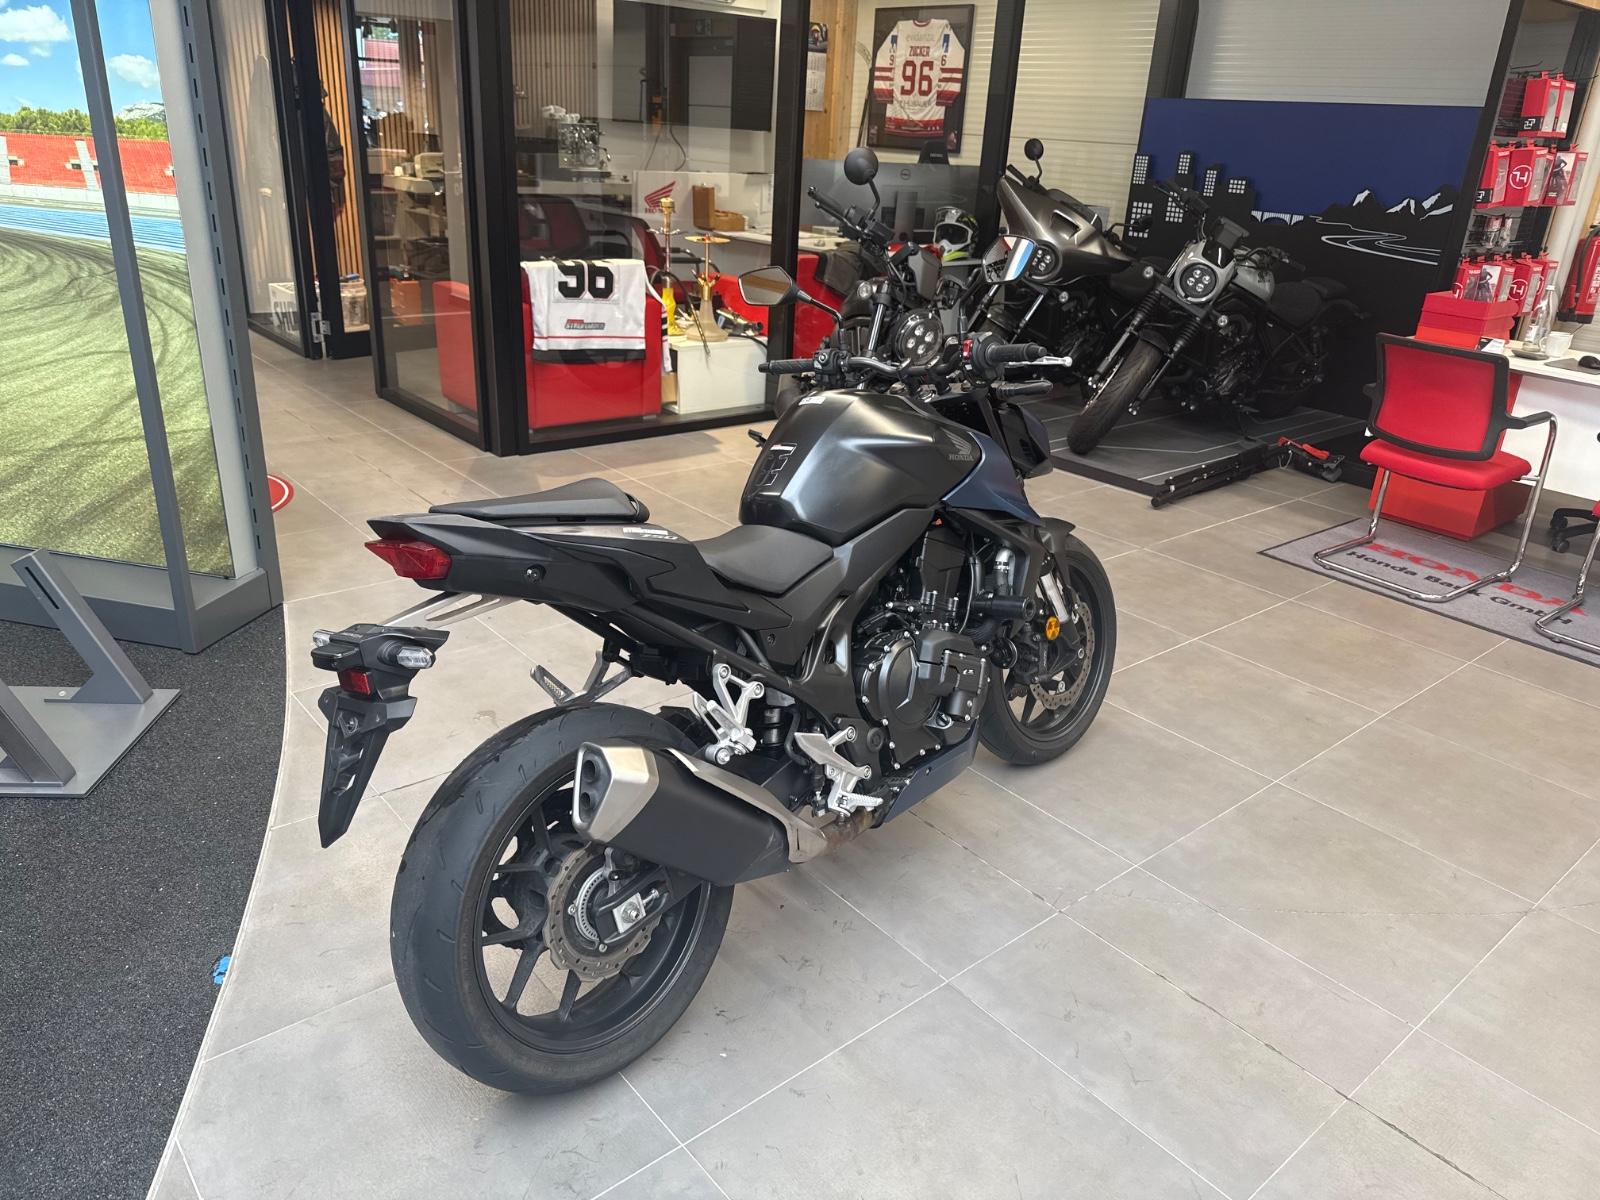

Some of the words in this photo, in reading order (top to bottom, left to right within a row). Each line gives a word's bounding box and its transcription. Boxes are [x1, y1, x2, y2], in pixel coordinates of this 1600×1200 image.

[900, 60, 934, 97] 96
[948, 453, 974, 461] HONDA
[1346, 550, 1418, 576] Honda
[1489, 595, 1574, 625] GmbH
